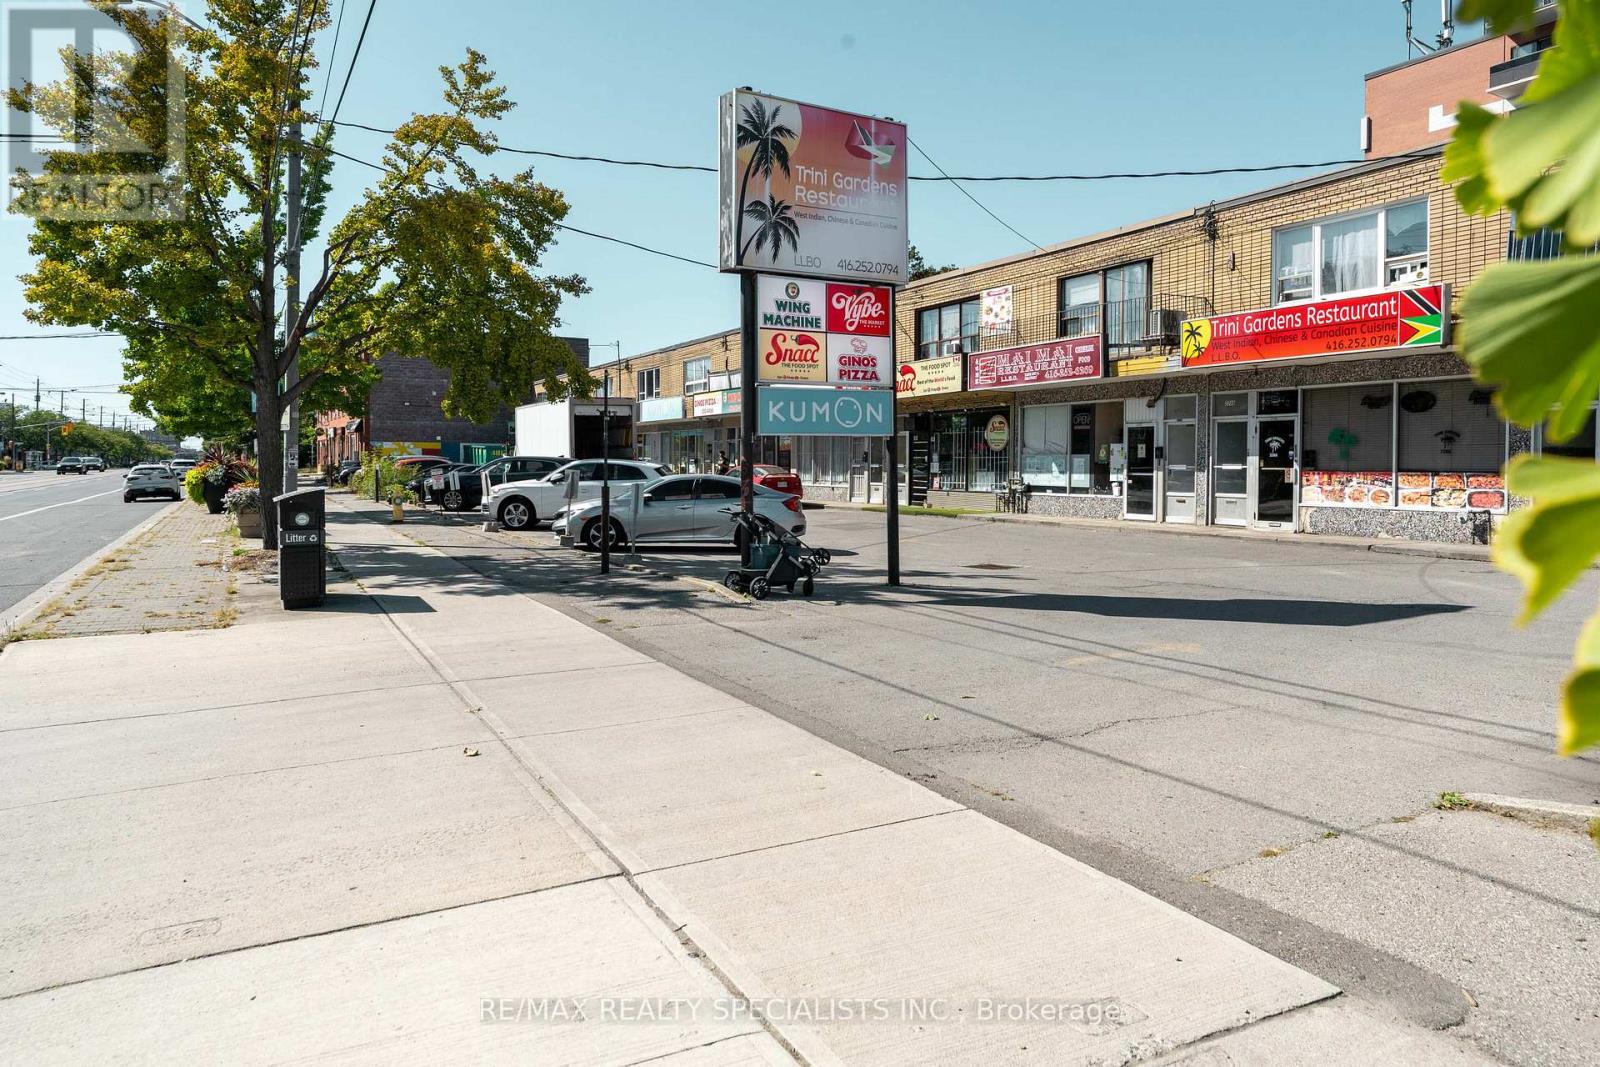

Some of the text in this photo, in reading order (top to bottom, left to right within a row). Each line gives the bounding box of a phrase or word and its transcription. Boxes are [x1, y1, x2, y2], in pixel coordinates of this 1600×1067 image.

[796, 165, 897, 195] Trini Gardens
[794, 255, 899, 274] LLBO 416.252.0794
[776, 300, 810, 314] WING
[832, 292, 885, 331] Vybe
[1211, 296, 1397, 337] Trini Gardens Restaurant
[763, 313, 821, 329] MACHINE
[1211, 341, 1230, 350] West
[1264, 334, 1298, 345] Chinese
[1301, 331, 1307, 340] &
[1311, 326, 1357, 340] Canadian
[1360, 321, 1397, 334] Cuisine
[1326, 335, 1396, 350] 416.252.0794
[765, 333, 820, 365] Snacc
[996, 345, 1073, 367] MAI MAI
[838, 355, 877, 368] GINO'S
[997, 358, 1073, 376] RESTAURANT
[839, 369, 880, 381] PIZZA
[769, 397, 882, 428] KUMON
[285, 533, 306, 543] Litter
